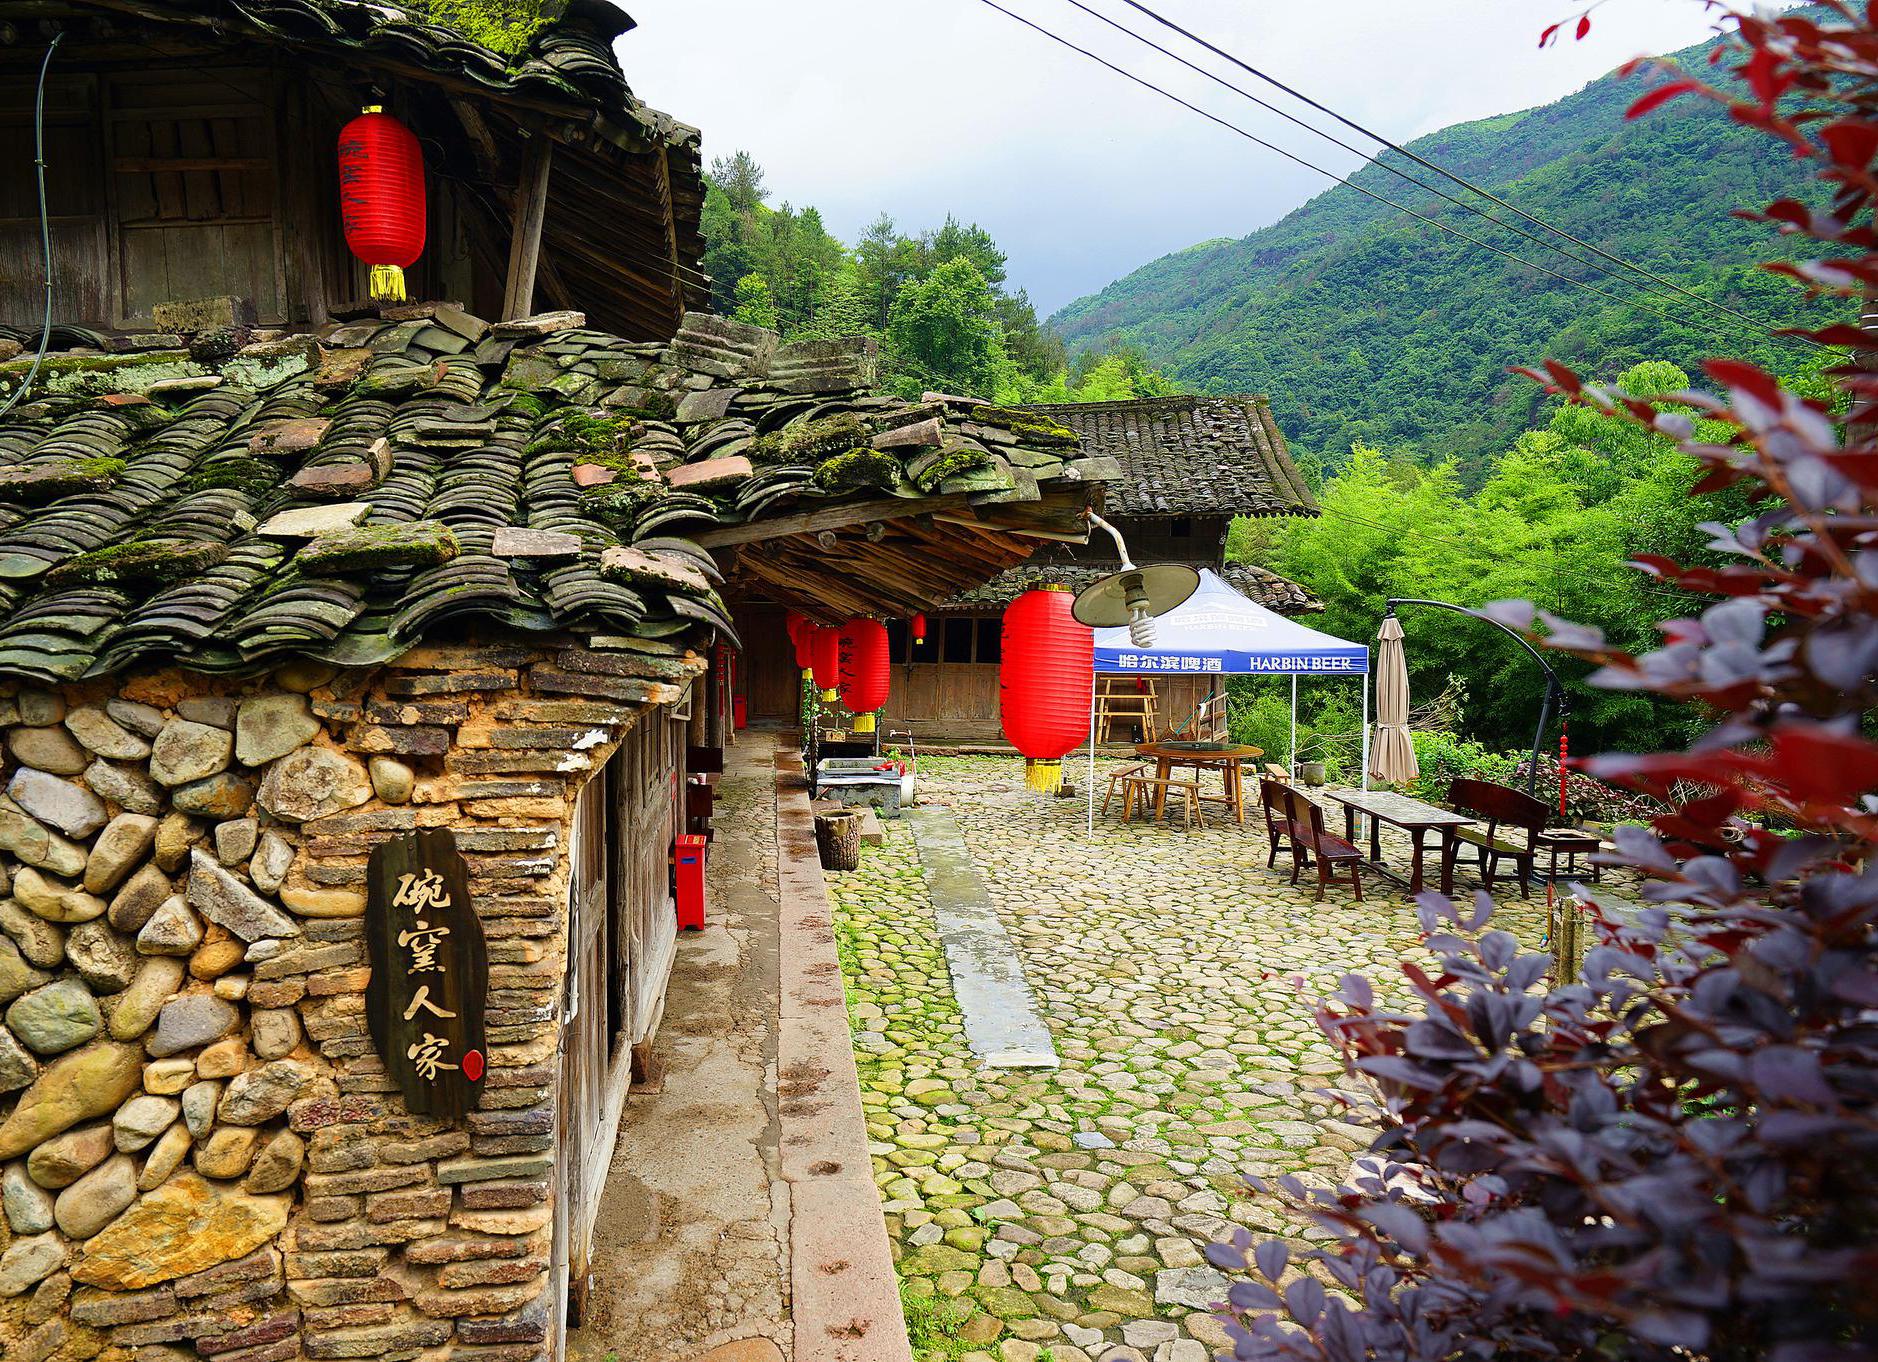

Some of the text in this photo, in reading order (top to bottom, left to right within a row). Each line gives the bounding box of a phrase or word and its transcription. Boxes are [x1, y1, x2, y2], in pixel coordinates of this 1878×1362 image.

[1118, 654, 1222, 671] 哈尔滨啤酒
[1249, 656, 1353, 671] HARBIN BEER
